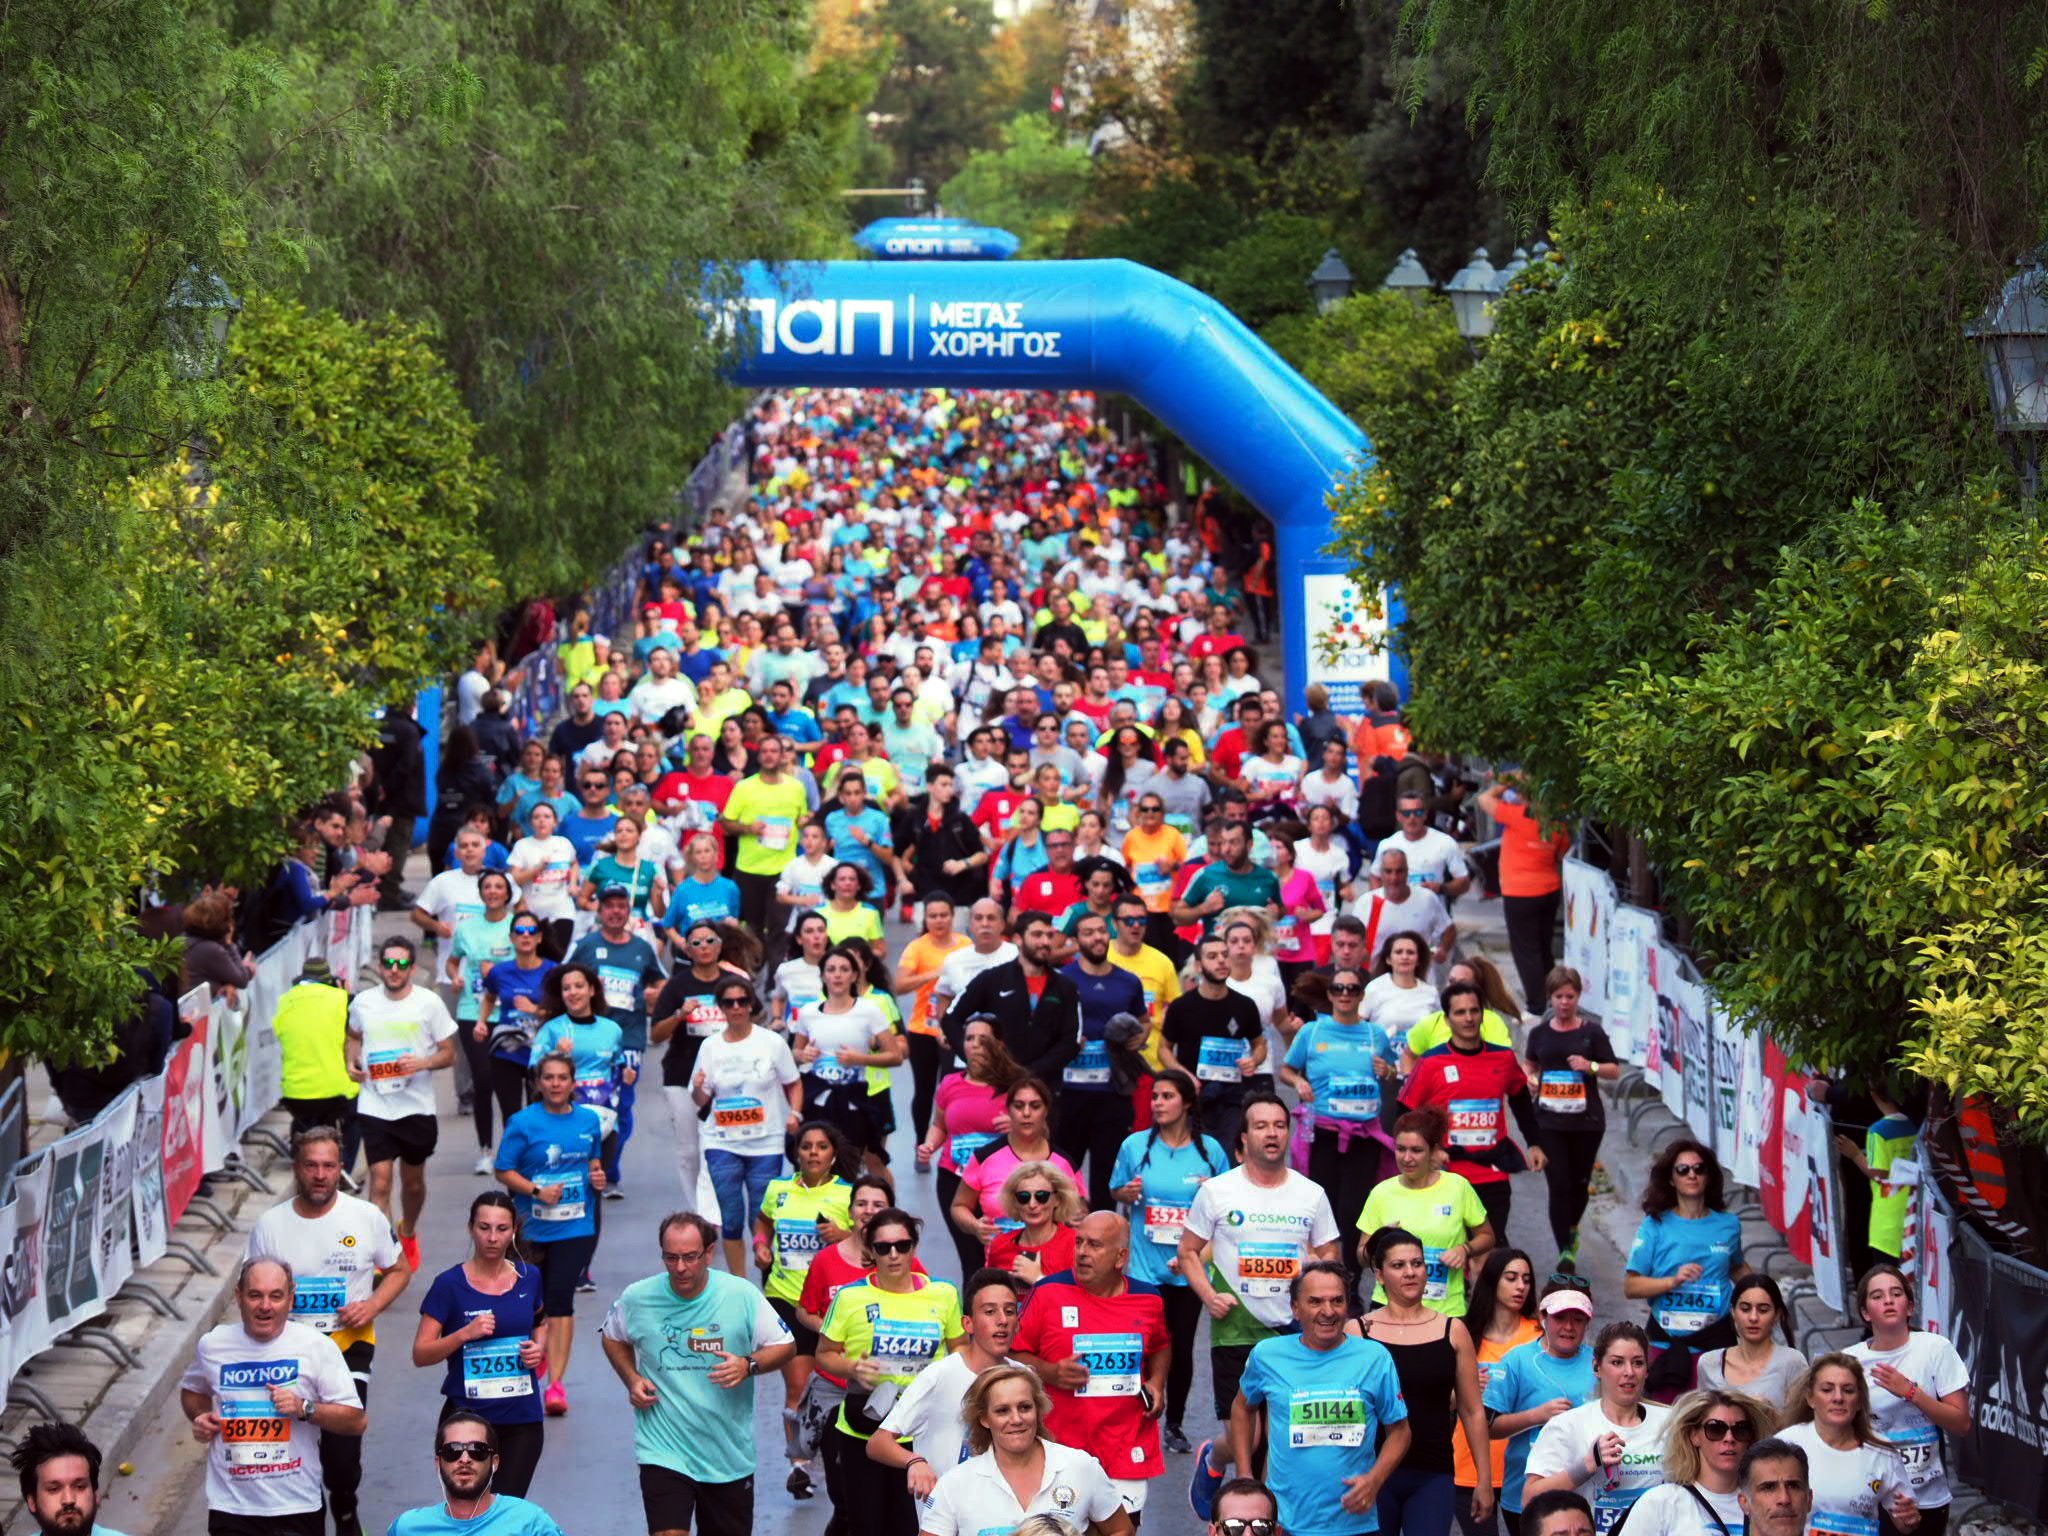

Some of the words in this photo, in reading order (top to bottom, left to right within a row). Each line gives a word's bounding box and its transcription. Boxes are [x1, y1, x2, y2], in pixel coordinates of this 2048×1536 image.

[930, 302, 1023, 330] ΜΕΓΑΣ
[930, 331, 1061, 358] ΧΟΡΗΓΟΣ
[1249, 1213, 1310, 1228] COSMOTE
[1243, 1258, 1294, 1275] 58505
[881, 1336, 934, 1357] 56443
[1081, 1353, 1137, 1371] 52635
[1302, 1401, 1355, 1420] 51144
[1980, 1398, 2016, 1438] adidas
[225, 1418, 284, 1438] 58799
[226, 1457, 304, 1477] actionaid
